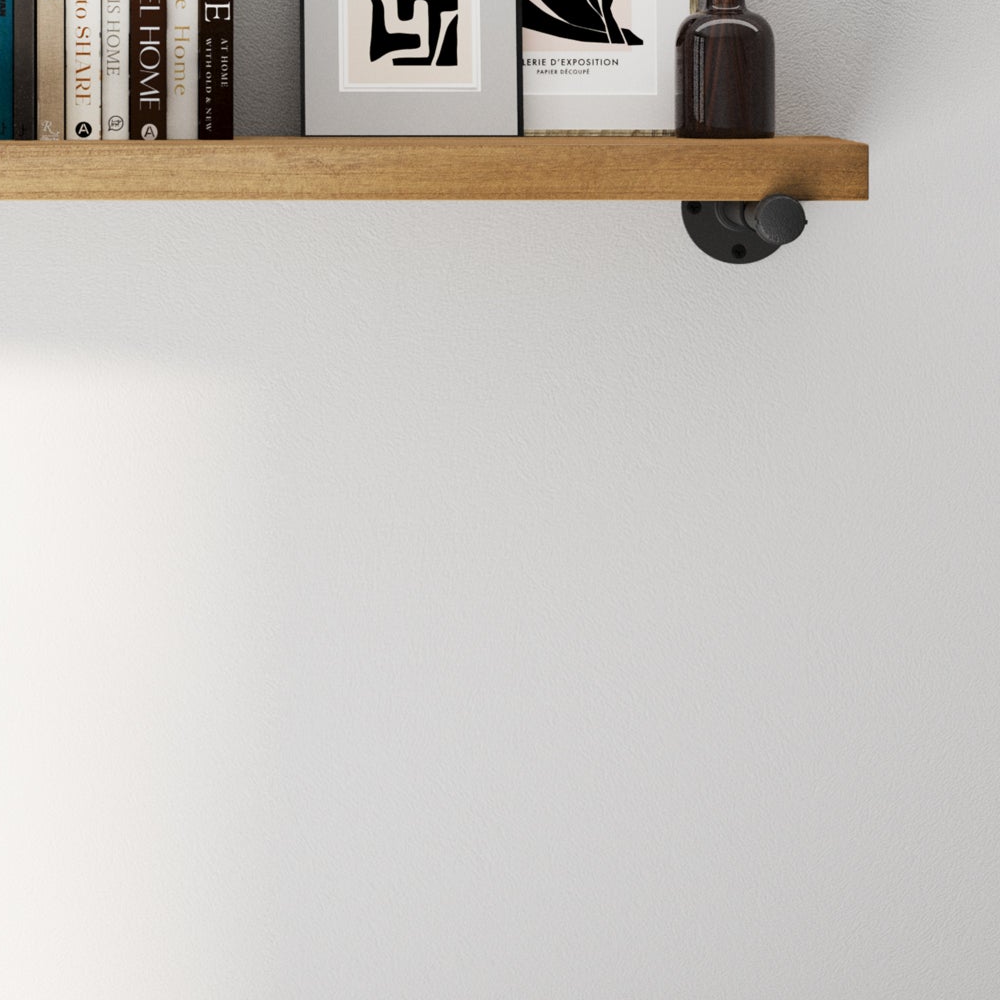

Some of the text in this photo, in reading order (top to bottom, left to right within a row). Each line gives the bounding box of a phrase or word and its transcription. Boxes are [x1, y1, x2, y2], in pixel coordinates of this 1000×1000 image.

[107, 0, 121, 14] IS
[75, 26, 91, 106] SHARE
[106, 20, 121, 76] HOME
[139, 26, 161, 111] HOME
[174, 25, 190, 96] Home
[220, 38, 229, 88] AT HOME
